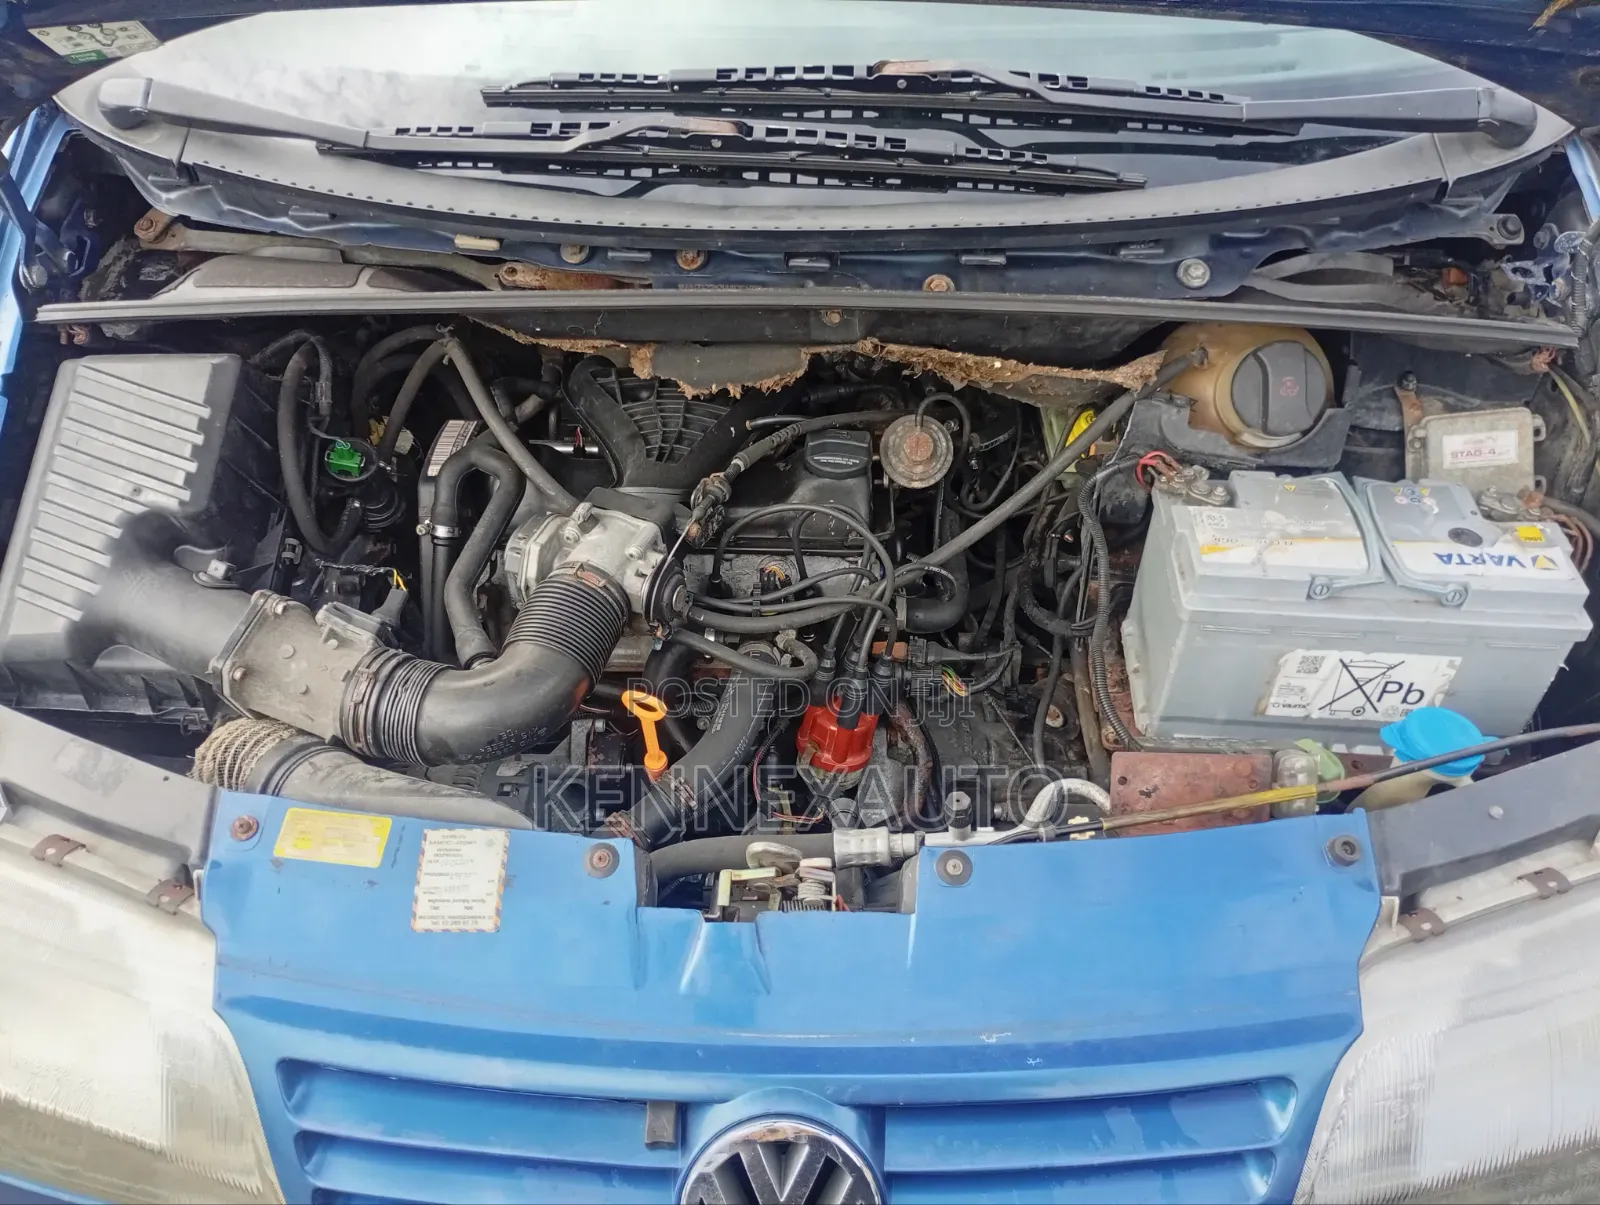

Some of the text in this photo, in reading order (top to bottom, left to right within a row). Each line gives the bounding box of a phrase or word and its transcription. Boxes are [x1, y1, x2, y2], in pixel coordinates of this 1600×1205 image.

[1450, 448, 1497, 459] STAG-4
[1432, 552, 1527, 569] VARTA
[1376, 681, 1425, 706] Pb
